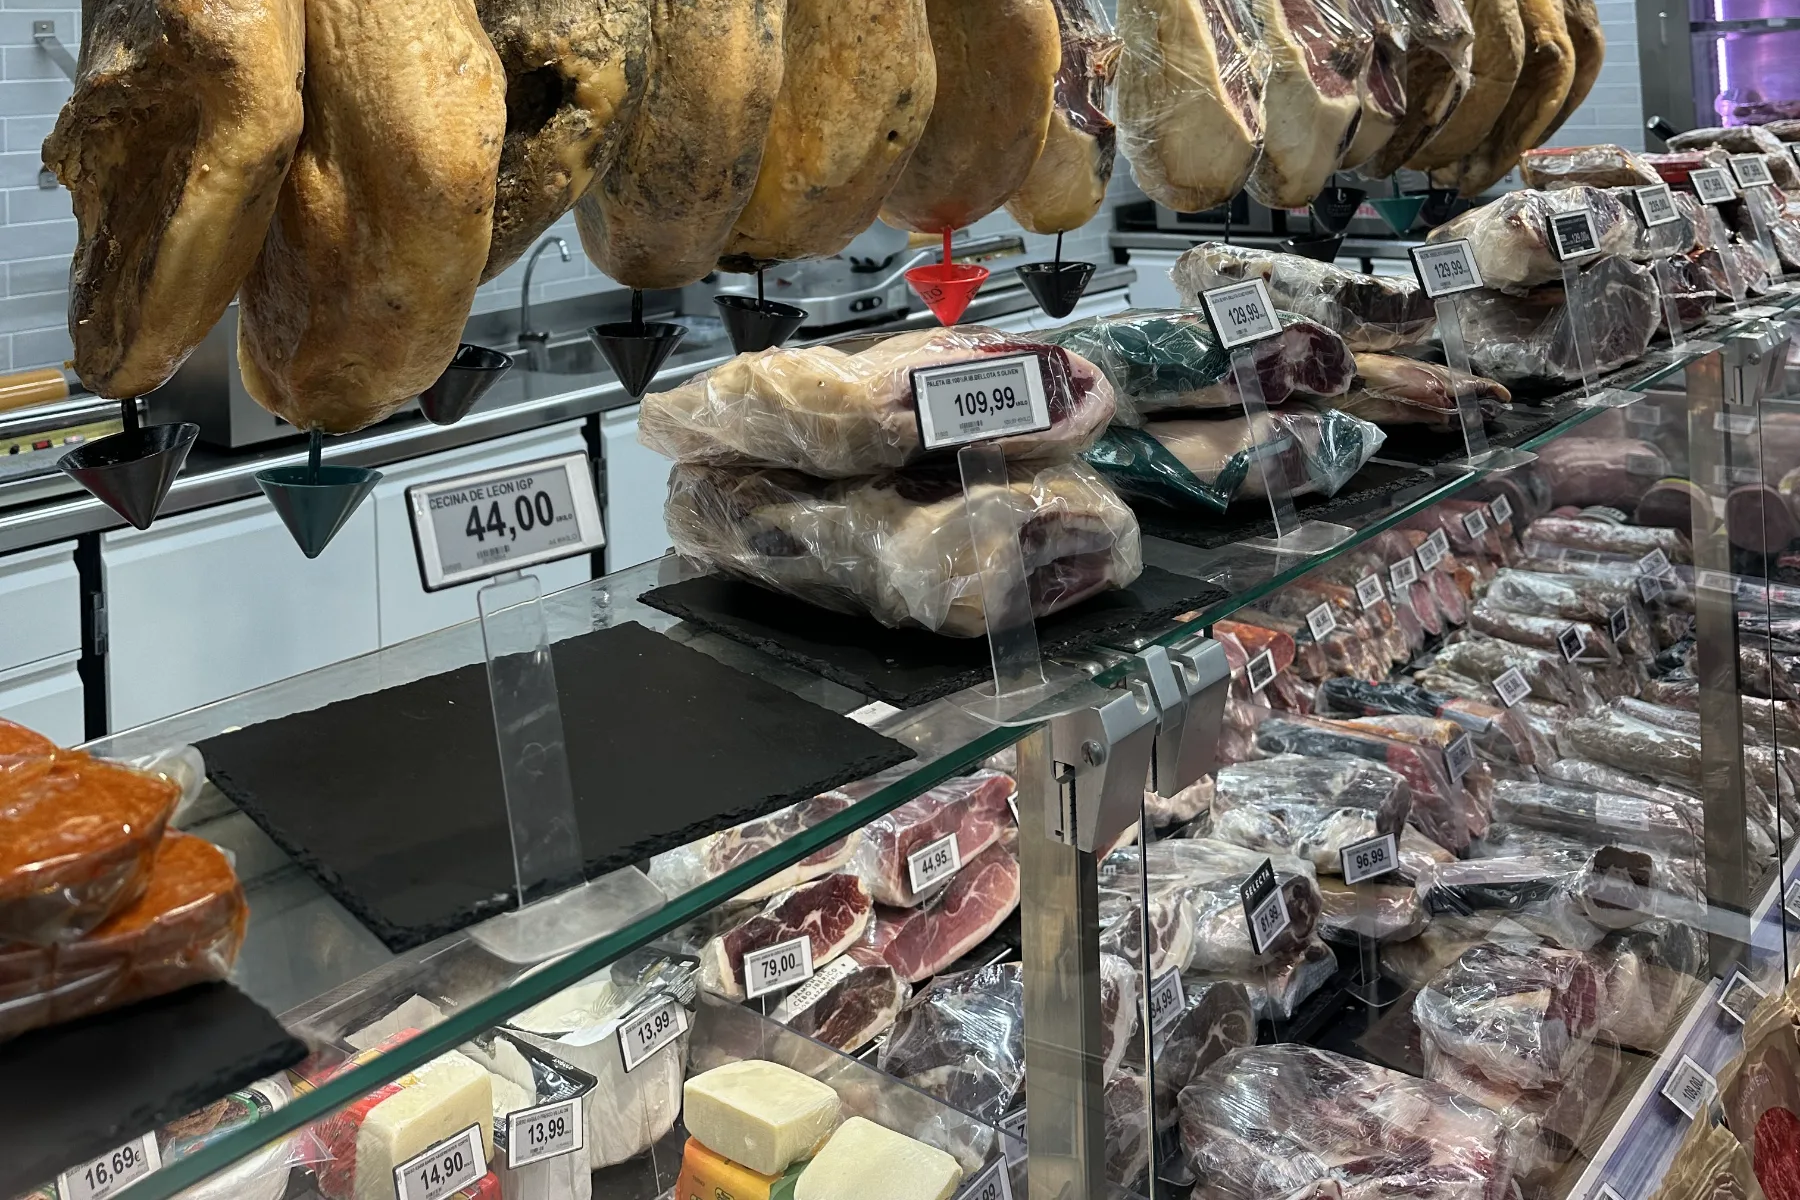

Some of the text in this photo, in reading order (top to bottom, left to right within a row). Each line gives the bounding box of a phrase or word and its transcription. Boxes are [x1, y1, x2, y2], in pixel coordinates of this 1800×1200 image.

[1434, 260, 1464, 279] 129,99
[1228, 303, 1260, 326] 129,99
[927, 379, 945, 388] PALETA
[954, 386, 1016, 417] 109,99
[429, 477, 534, 510] CECINA DE LEON IGP
[466, 490, 554, 542] 44,00
[922, 850, 947, 873] 44,95
[1357, 848, 1384, 869] 96,99
[1245, 869, 1270, 899] SELECTA
[1261, 905, 1279, 932] 81,99
[762, 953, 796, 978] 79,00
[638, 1011, 670, 1044] 13,99
[1682, 1077, 1704, 1102] 109,00
[528, 1117, 565, 1145] 13,99
[421, 1151, 463, 1191] 14,90
